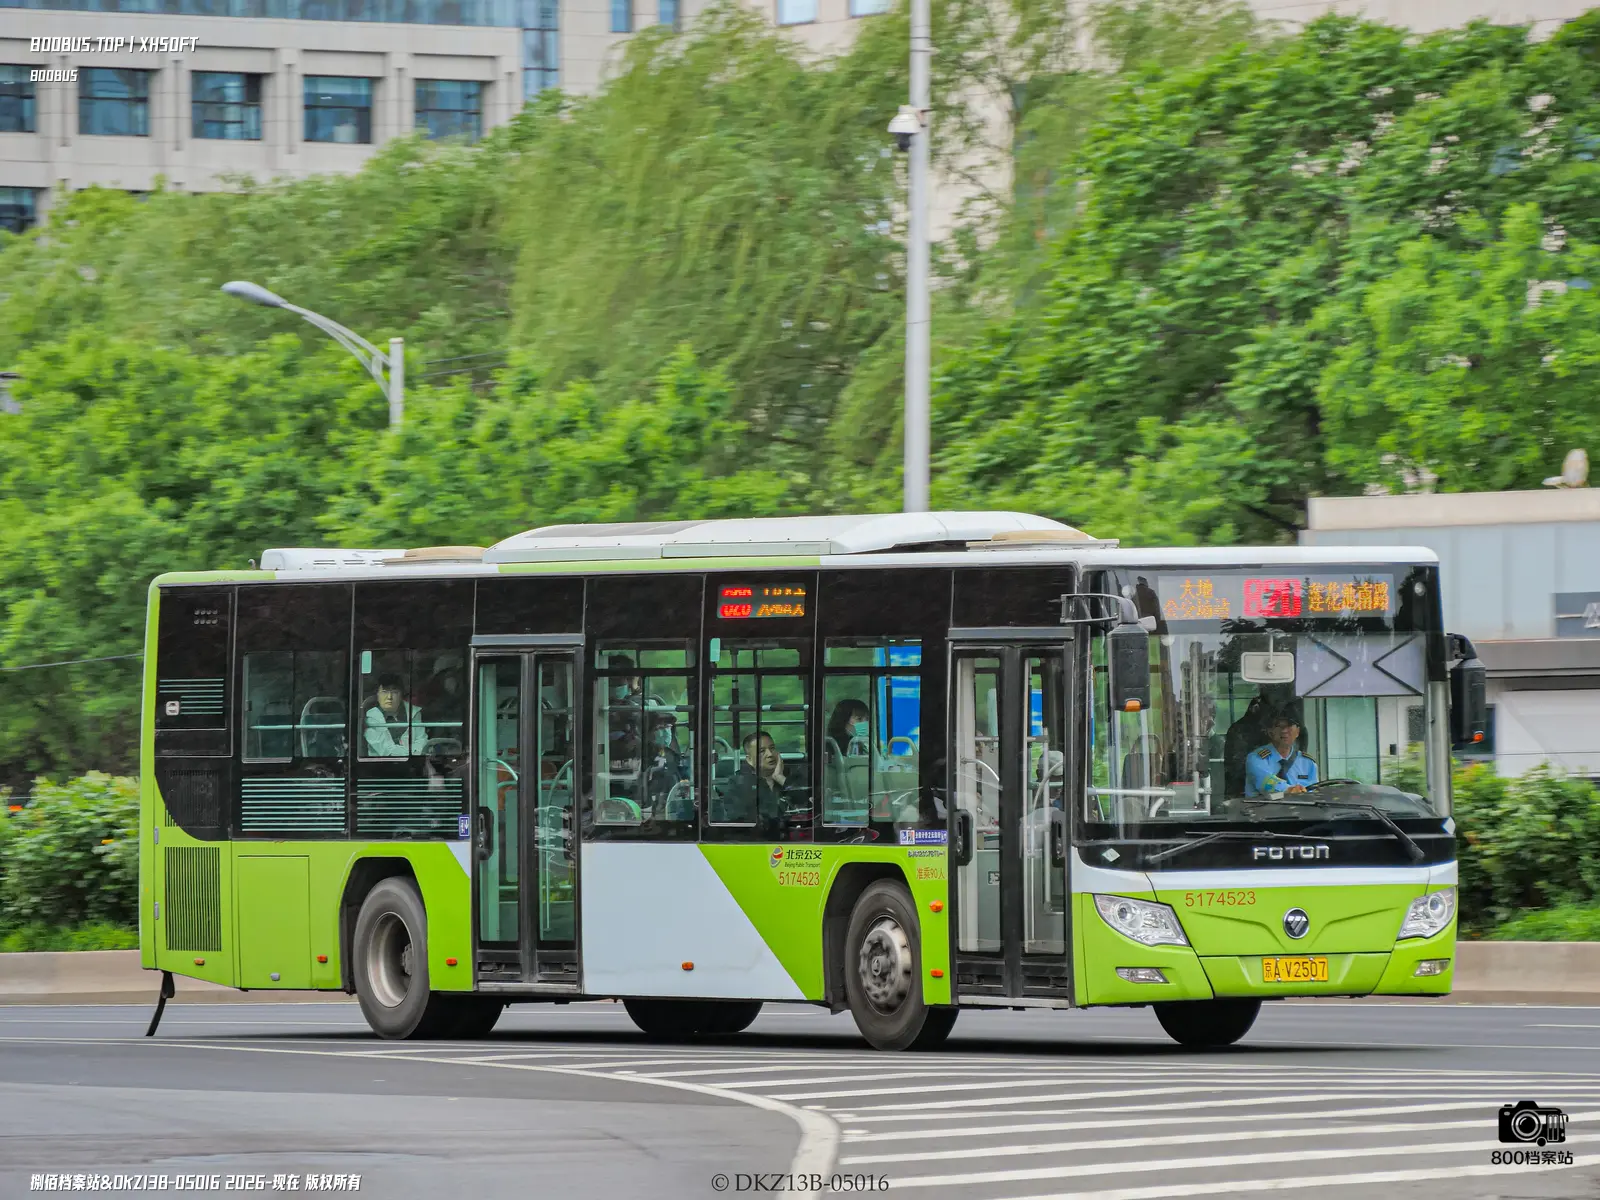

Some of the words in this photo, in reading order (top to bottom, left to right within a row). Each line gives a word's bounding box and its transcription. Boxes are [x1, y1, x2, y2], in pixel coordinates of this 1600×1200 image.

[1179, 578, 1213, 598] 大地
[785, 849, 822, 860] 北京公交
[1253, 845, 1330, 860] FOTON
[779, 871, 820, 886] 5174523
[1185, 891, 1256, 907] 5174523
